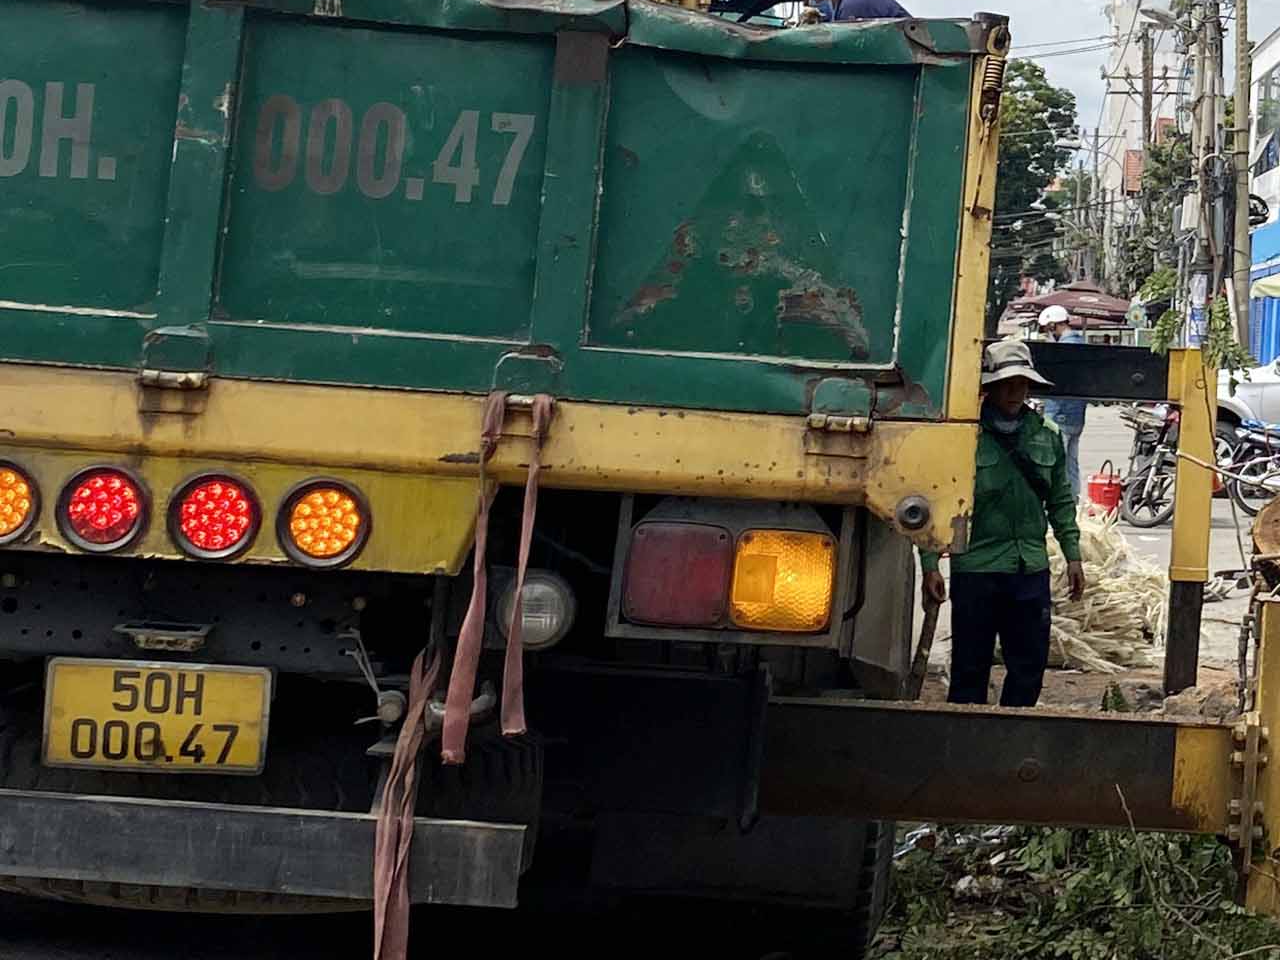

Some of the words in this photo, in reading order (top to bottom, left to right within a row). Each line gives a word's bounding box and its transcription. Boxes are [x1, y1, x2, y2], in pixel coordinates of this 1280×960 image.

[253, 94, 537, 205] 000.47
[112, 670, 206, 716] 50H
[69, 717, 241, 766] 000.47
